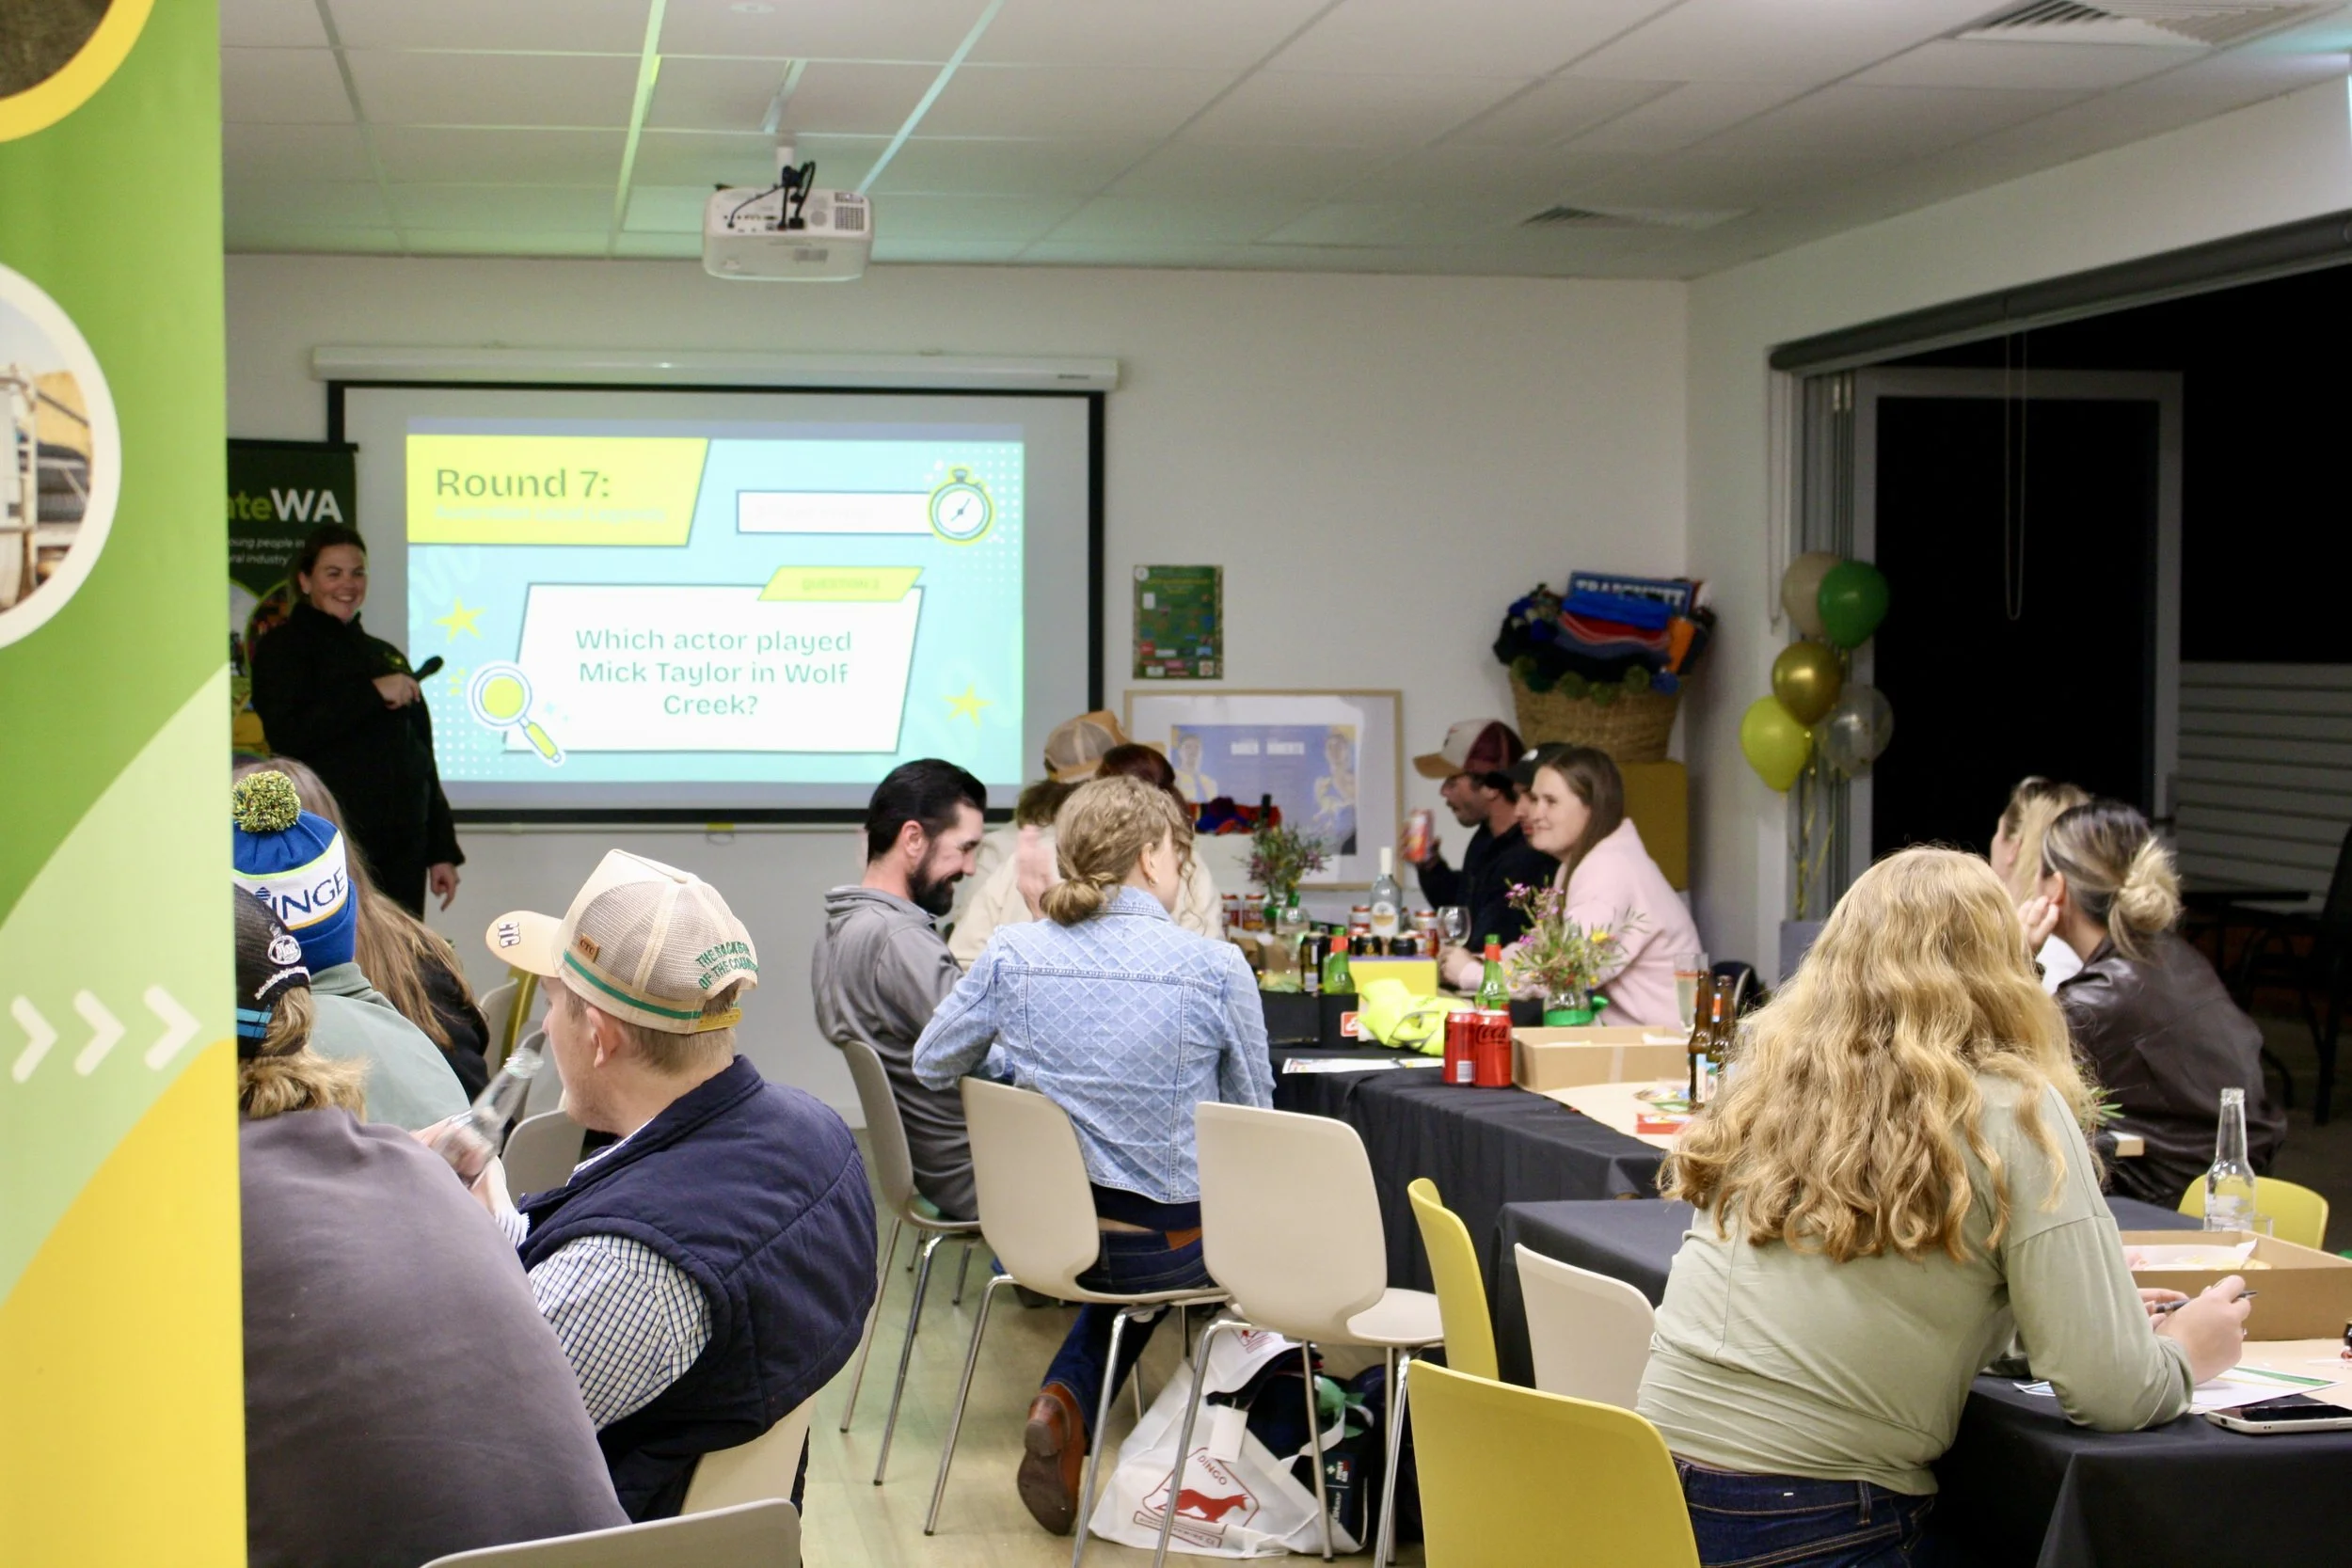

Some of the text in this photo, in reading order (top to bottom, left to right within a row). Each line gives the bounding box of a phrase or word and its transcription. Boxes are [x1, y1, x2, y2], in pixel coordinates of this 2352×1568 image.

[437, 468, 609, 498] Round 7:
[256, 537, 294, 550] people
[294, 538, 307, 549] in
[575, 627, 851, 657] Which actor played
[580, 660, 849, 688] Mick Taylor in Wolf
[663, 694, 758, 716] Creek?
[695, 949, 718, 968] THE
[711, 960, 731, 977] THE
[1196, 1454, 1228, 1486] DINGO
